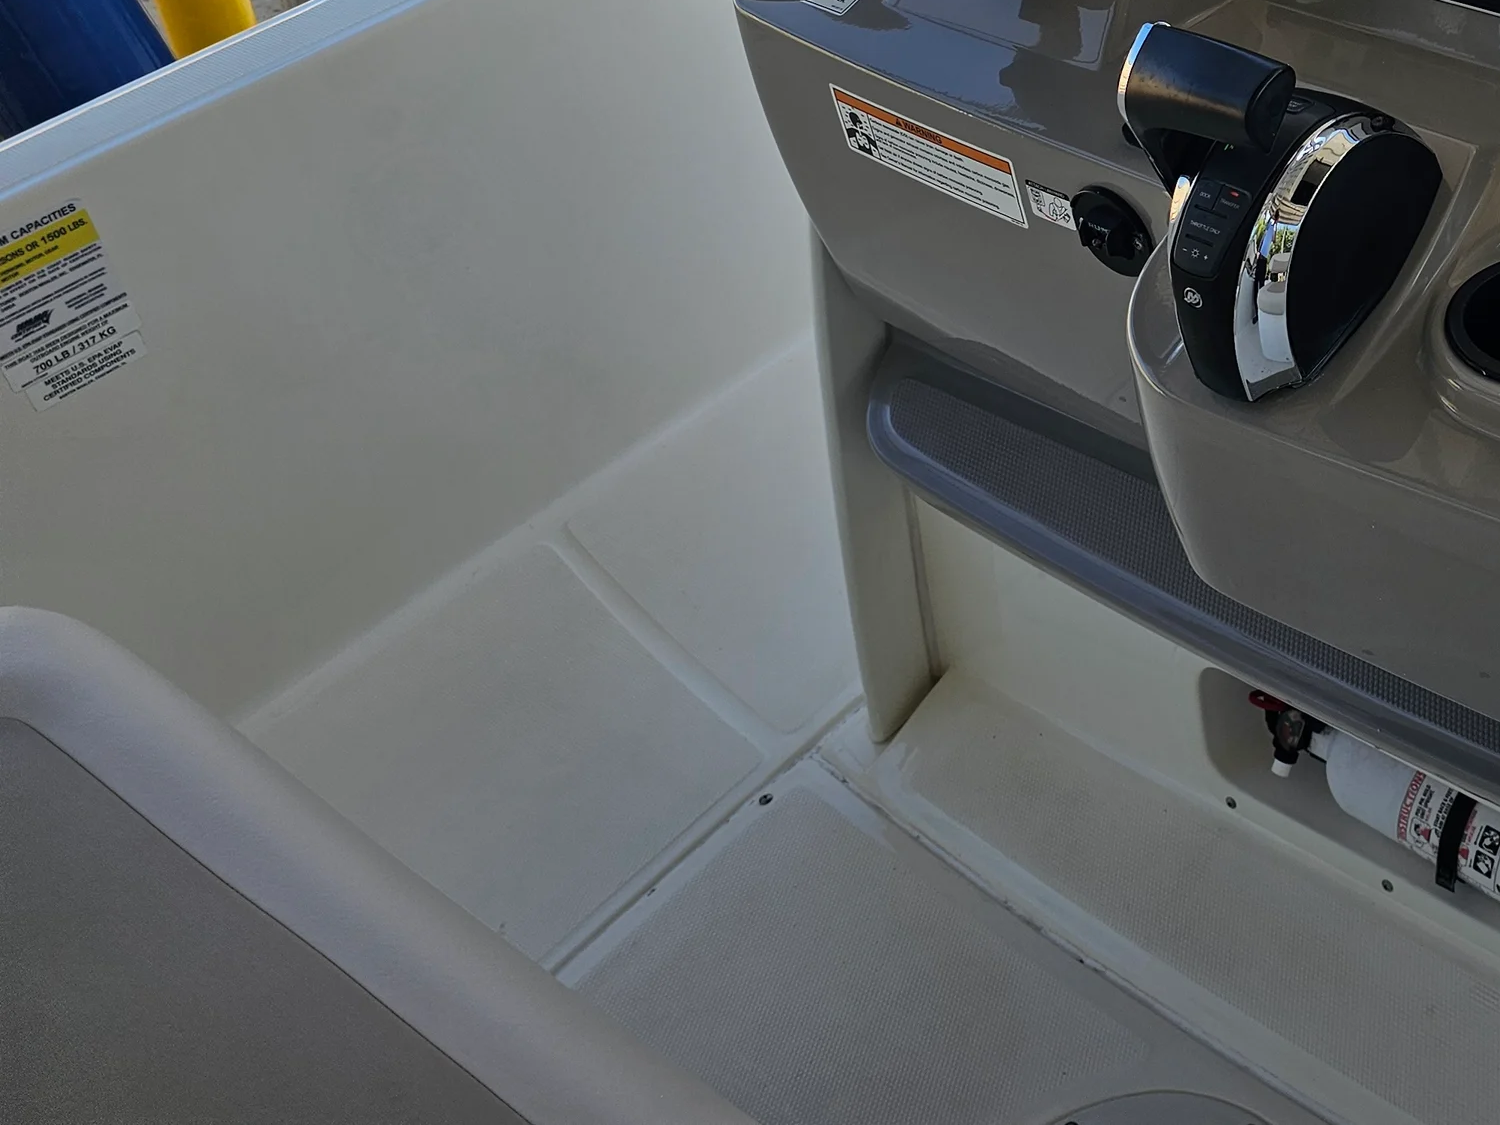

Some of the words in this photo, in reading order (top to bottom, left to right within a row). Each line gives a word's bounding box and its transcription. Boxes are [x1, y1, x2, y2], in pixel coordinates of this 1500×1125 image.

[902, 119, 942, 145] WARNING
[9, 202, 76, 240] CAPACITIES
[24, 240, 40, 252] OR
[39, 226, 67, 245] 1500
[66, 216, 88, 232] LBS.
[32, 358, 54, 375] 700
[53, 349, 71, 363] LB
[77, 334, 98, 351] 317
[98, 325, 116, 339] KG
[43, 368, 70, 387] MEETS
[70, 359, 86, 372] U.S.
[86, 350, 103, 363] EPA
[102, 339, 124, 354] EVAP
[51, 360, 98, 390] STANDARDS
[97, 347, 122, 365] USING
[42, 375, 83, 402] CERTIFIED
[82, 347, 136, 380] COMPONENTS
